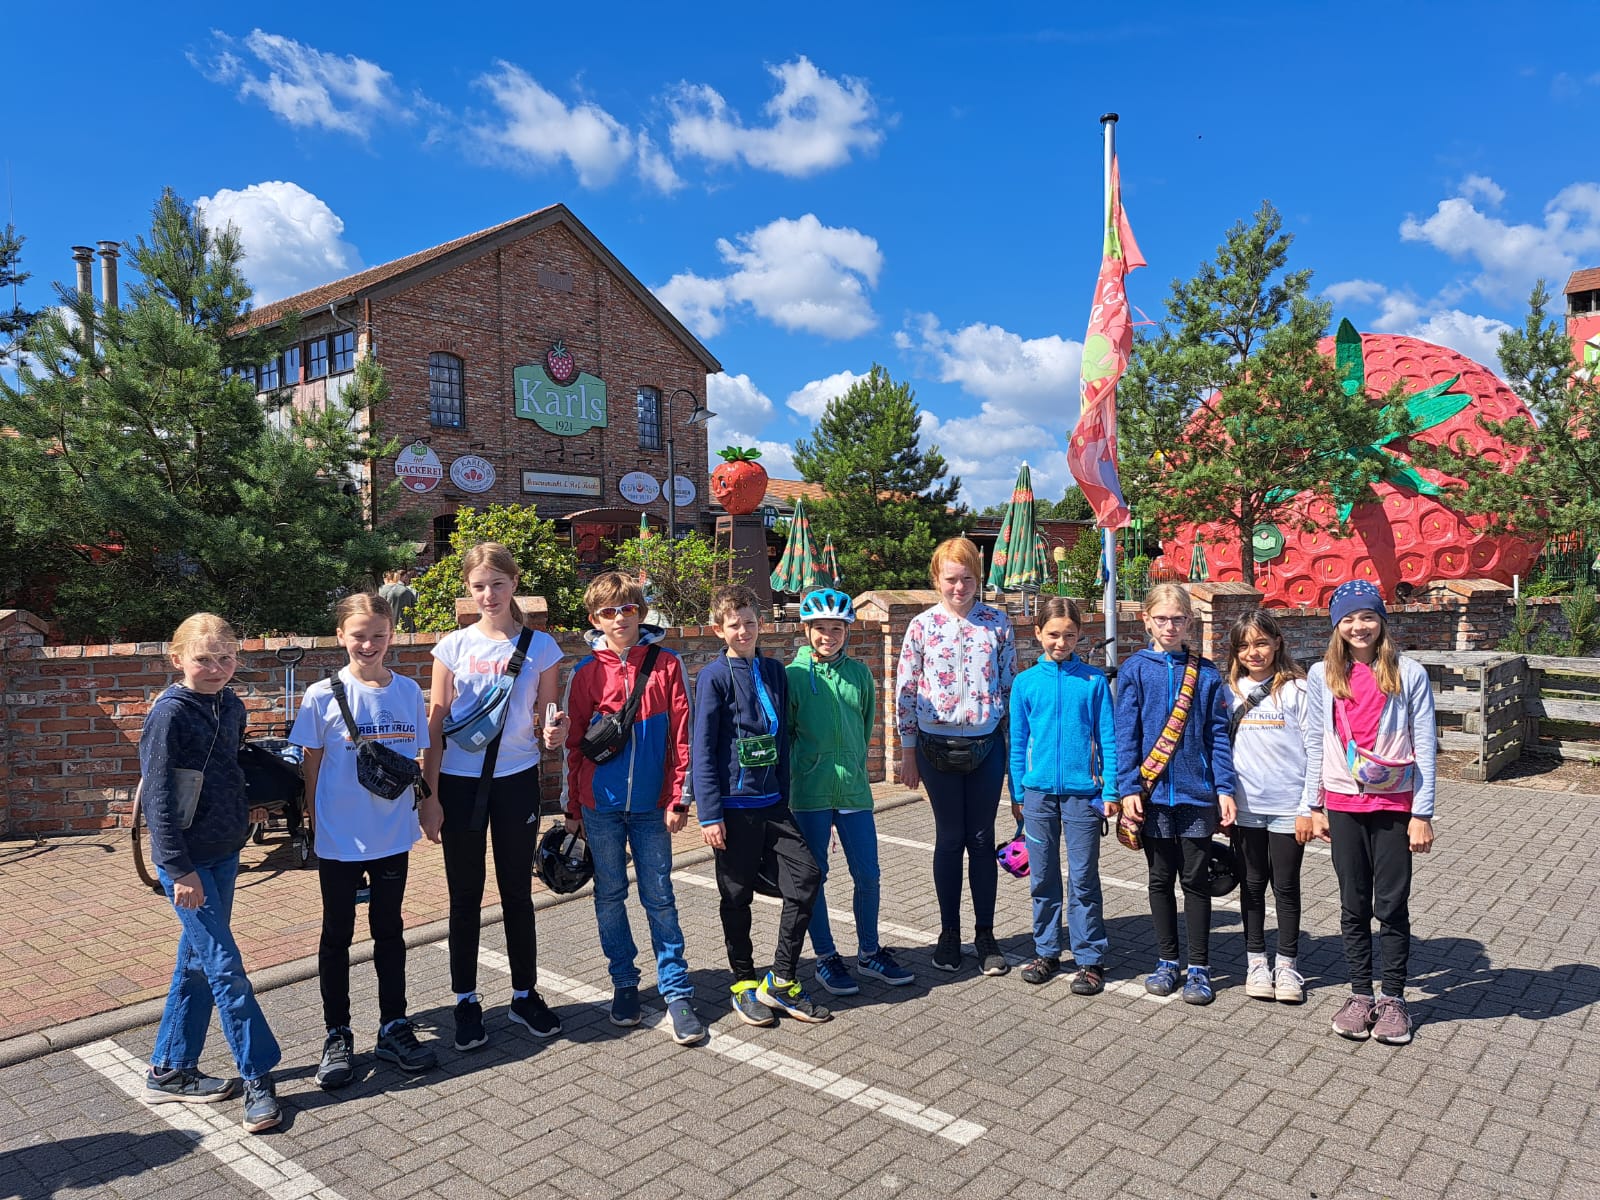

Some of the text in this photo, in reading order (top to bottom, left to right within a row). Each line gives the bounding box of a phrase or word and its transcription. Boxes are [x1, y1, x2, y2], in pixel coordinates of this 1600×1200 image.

[520, 378, 602, 421] Karls
[555, 420, 573, 432] 1921
[460, 459, 487, 470] KARLS
[1259, 713, 1285, 721] KRUG
[358, 724, 416, 735] RBERT KRUG
